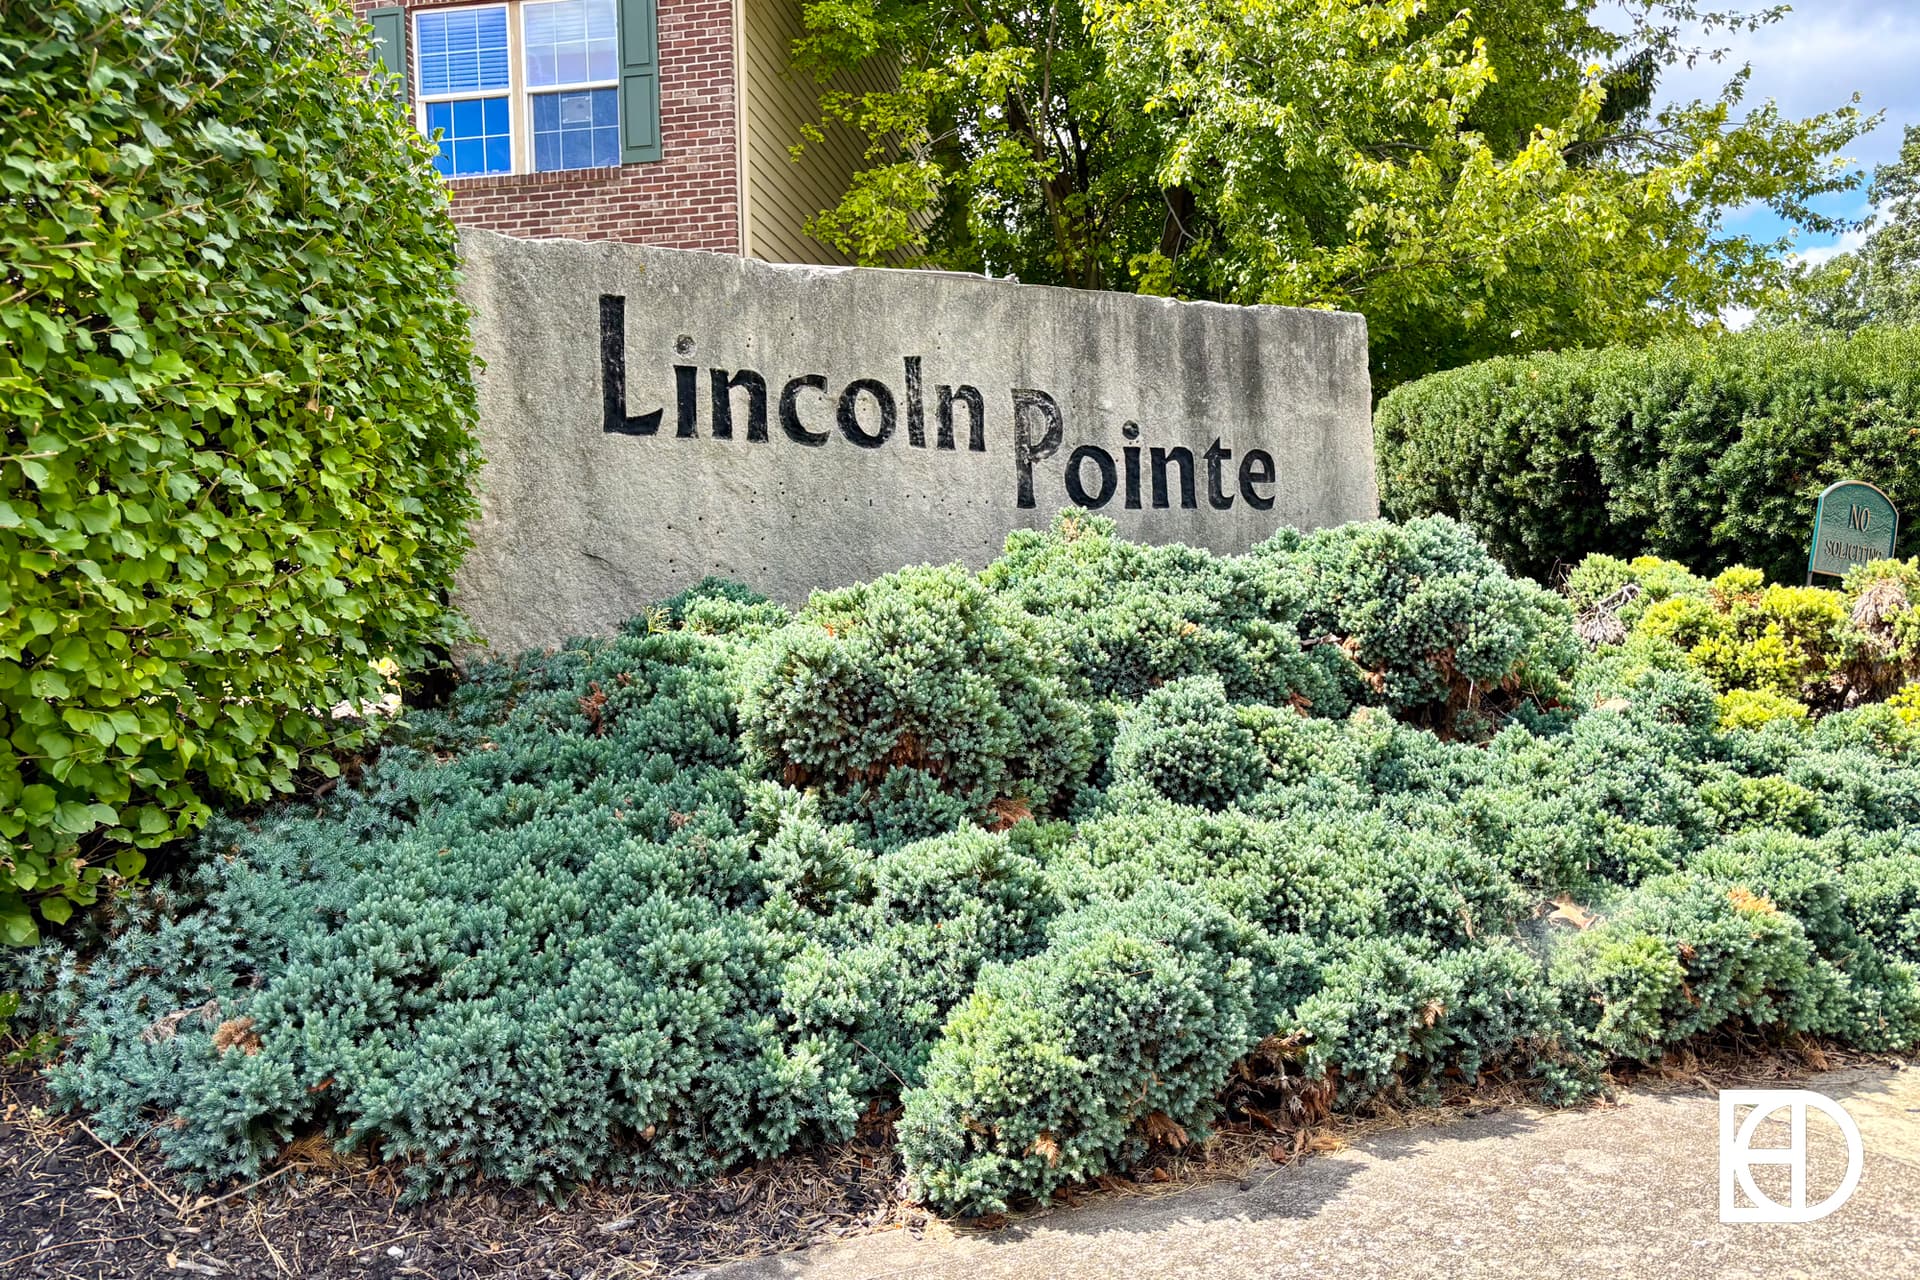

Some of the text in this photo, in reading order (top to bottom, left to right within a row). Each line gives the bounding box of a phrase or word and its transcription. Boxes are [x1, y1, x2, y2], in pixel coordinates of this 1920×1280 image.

[599, 294, 1276, 511] Lincoln Pointe
[1848, 504, 1871, 533] NO
